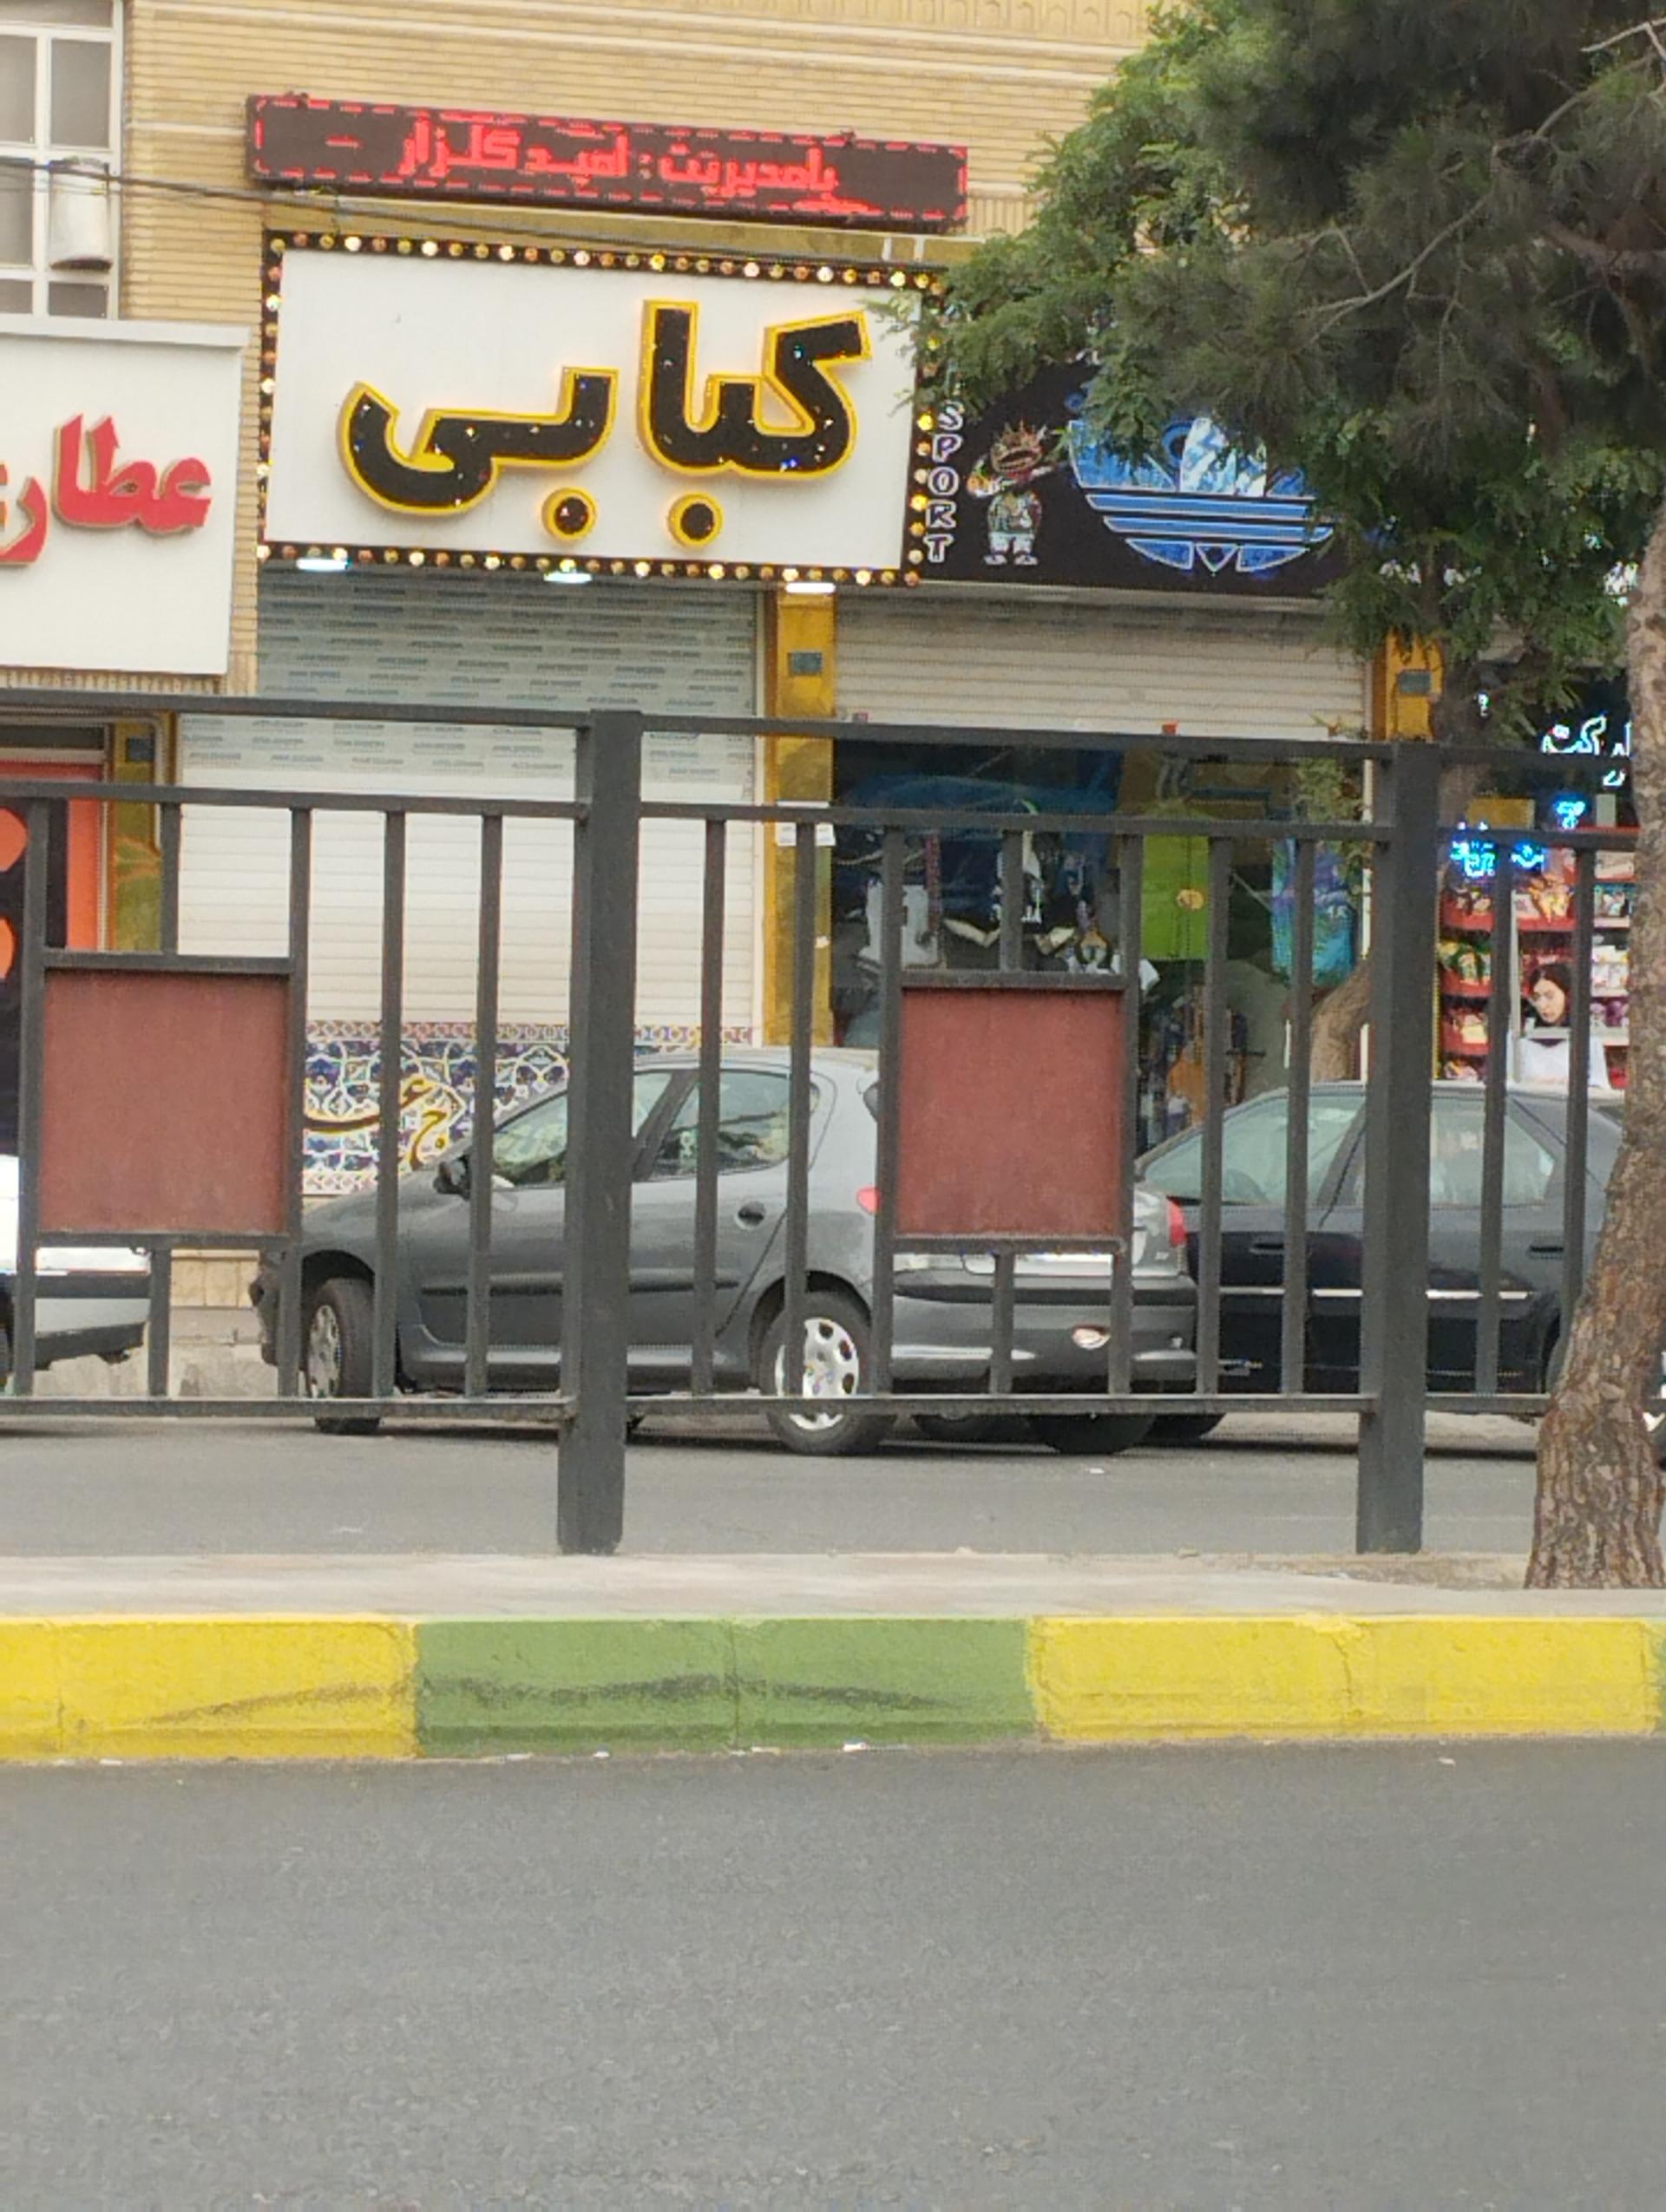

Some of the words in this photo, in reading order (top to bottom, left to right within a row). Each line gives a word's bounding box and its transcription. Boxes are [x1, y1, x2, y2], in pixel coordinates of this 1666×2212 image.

[0, 413, 213, 569] عطار
[337, 298, 871, 550] کبابی
[922, 400, 965, 564] SPORT
